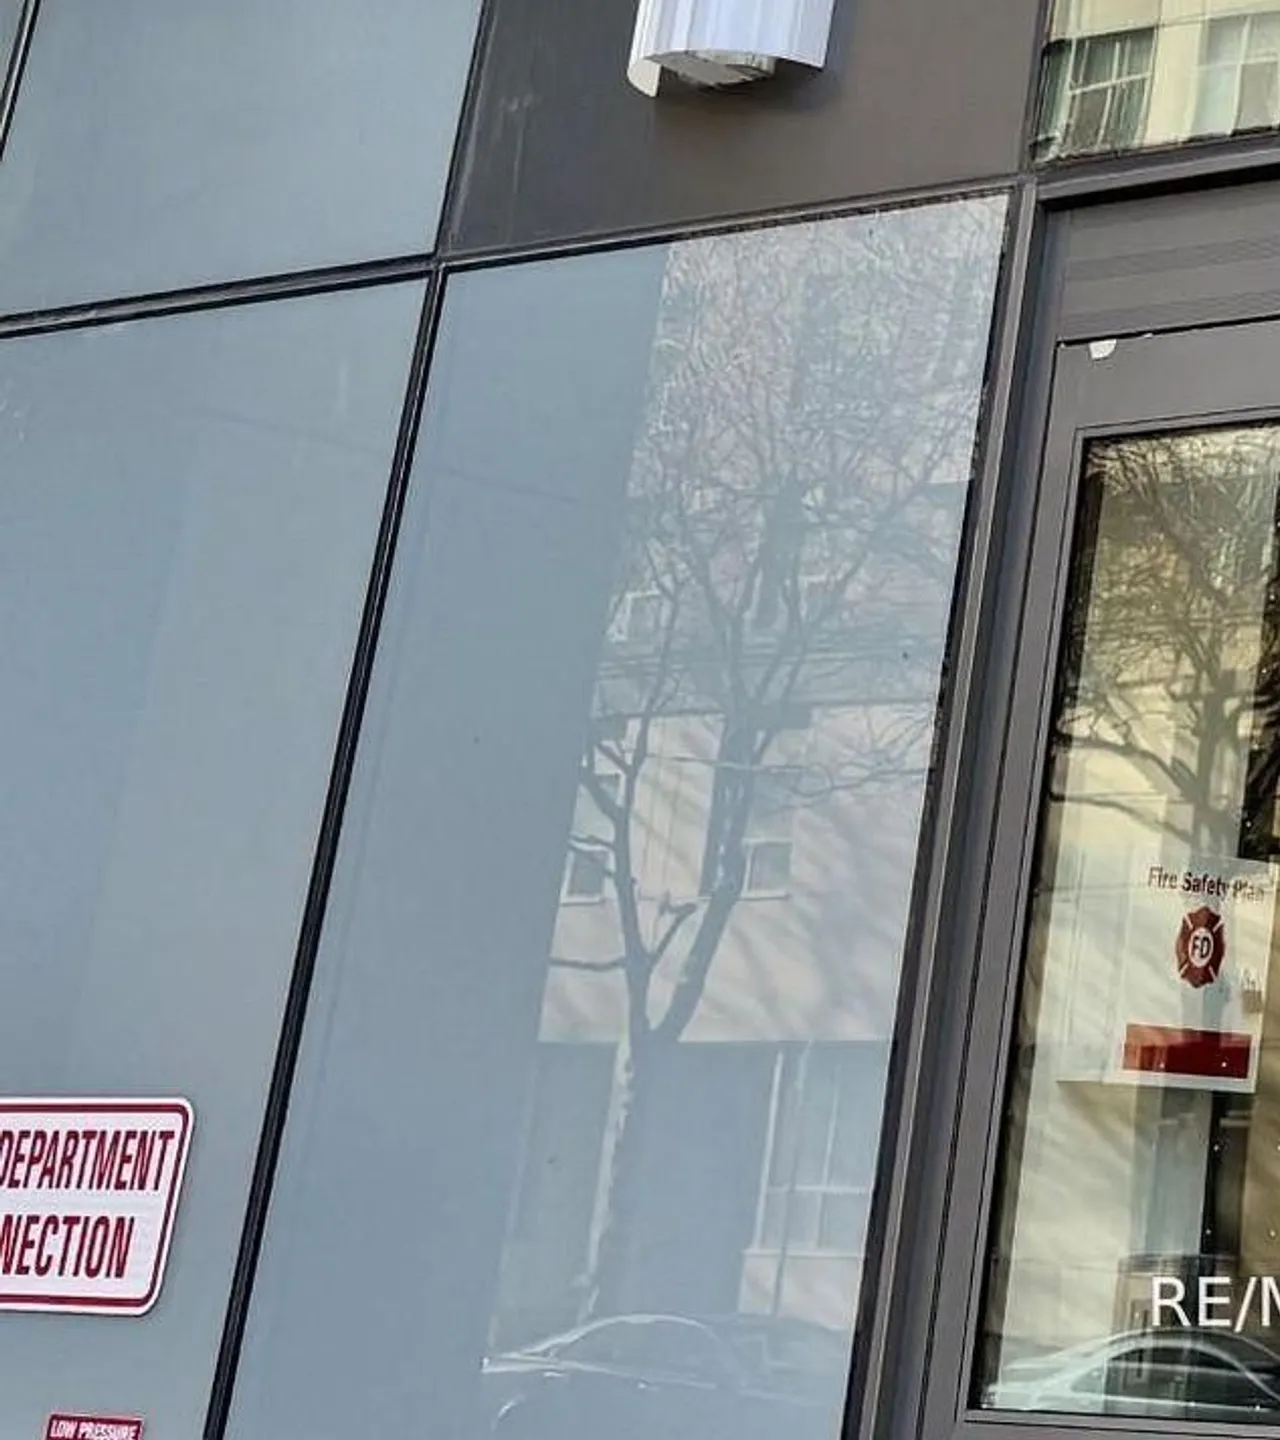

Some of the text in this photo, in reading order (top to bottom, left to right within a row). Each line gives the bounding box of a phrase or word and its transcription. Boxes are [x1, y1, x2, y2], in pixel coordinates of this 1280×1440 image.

[1147, 865, 1179, 890] Fire
[1181, 871, 1231, 898] Safety
[1191, 935, 1213, 959] FD
[0, 1130, 175, 1191] DEPARTMENT
[50, 1419, 78, 1439] LOW
